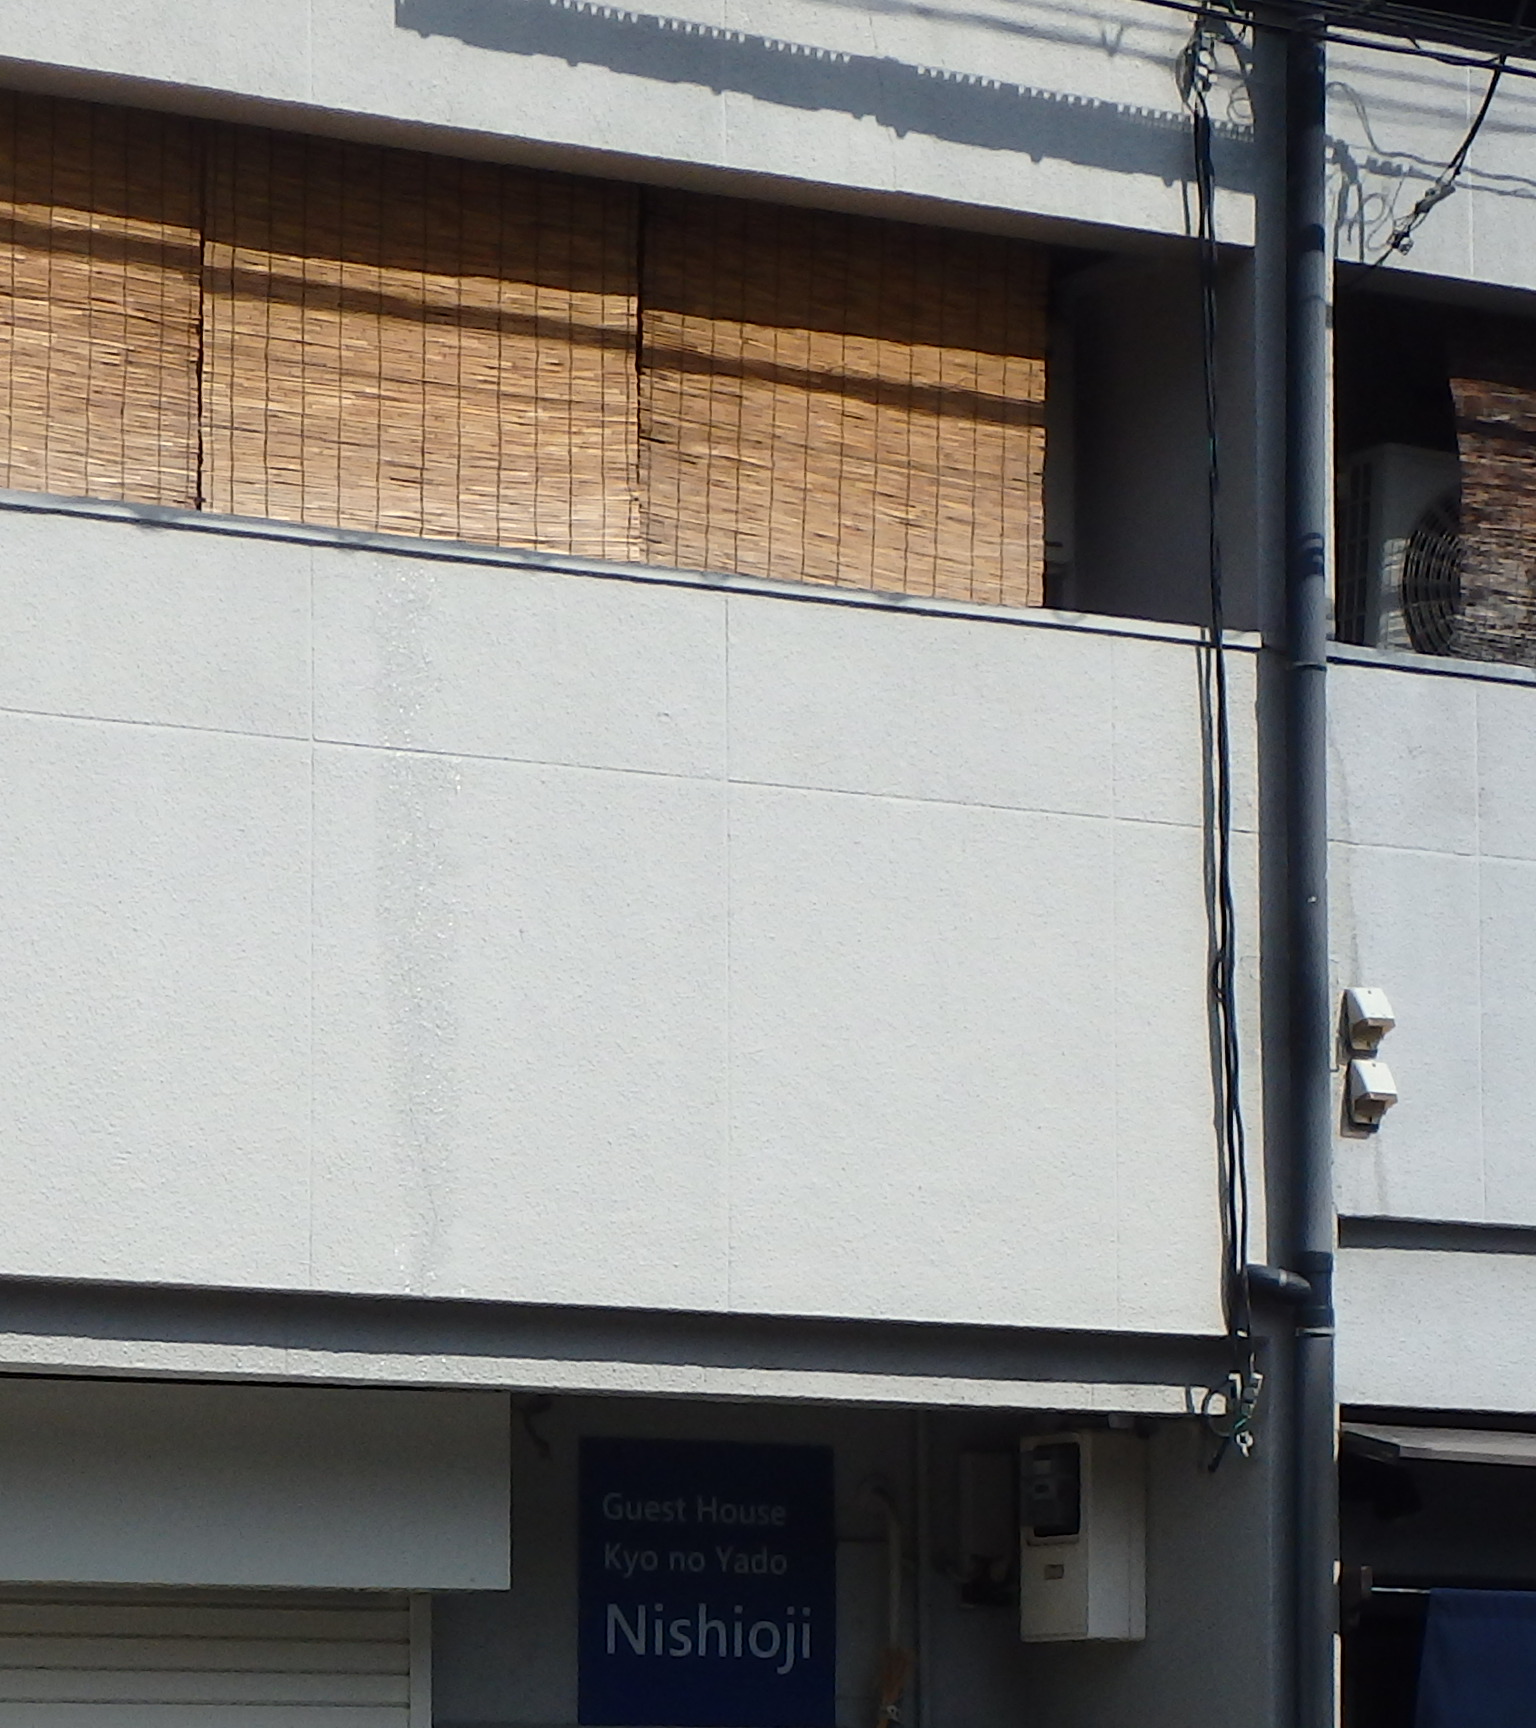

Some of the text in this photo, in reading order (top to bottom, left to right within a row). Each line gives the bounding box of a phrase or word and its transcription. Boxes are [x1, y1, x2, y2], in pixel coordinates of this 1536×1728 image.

[602, 1492, 787, 1526] Guest House
[604, 1542, 789, 1579] Kyo no Yado
[606, 1602, 812, 1675] Nishioji
